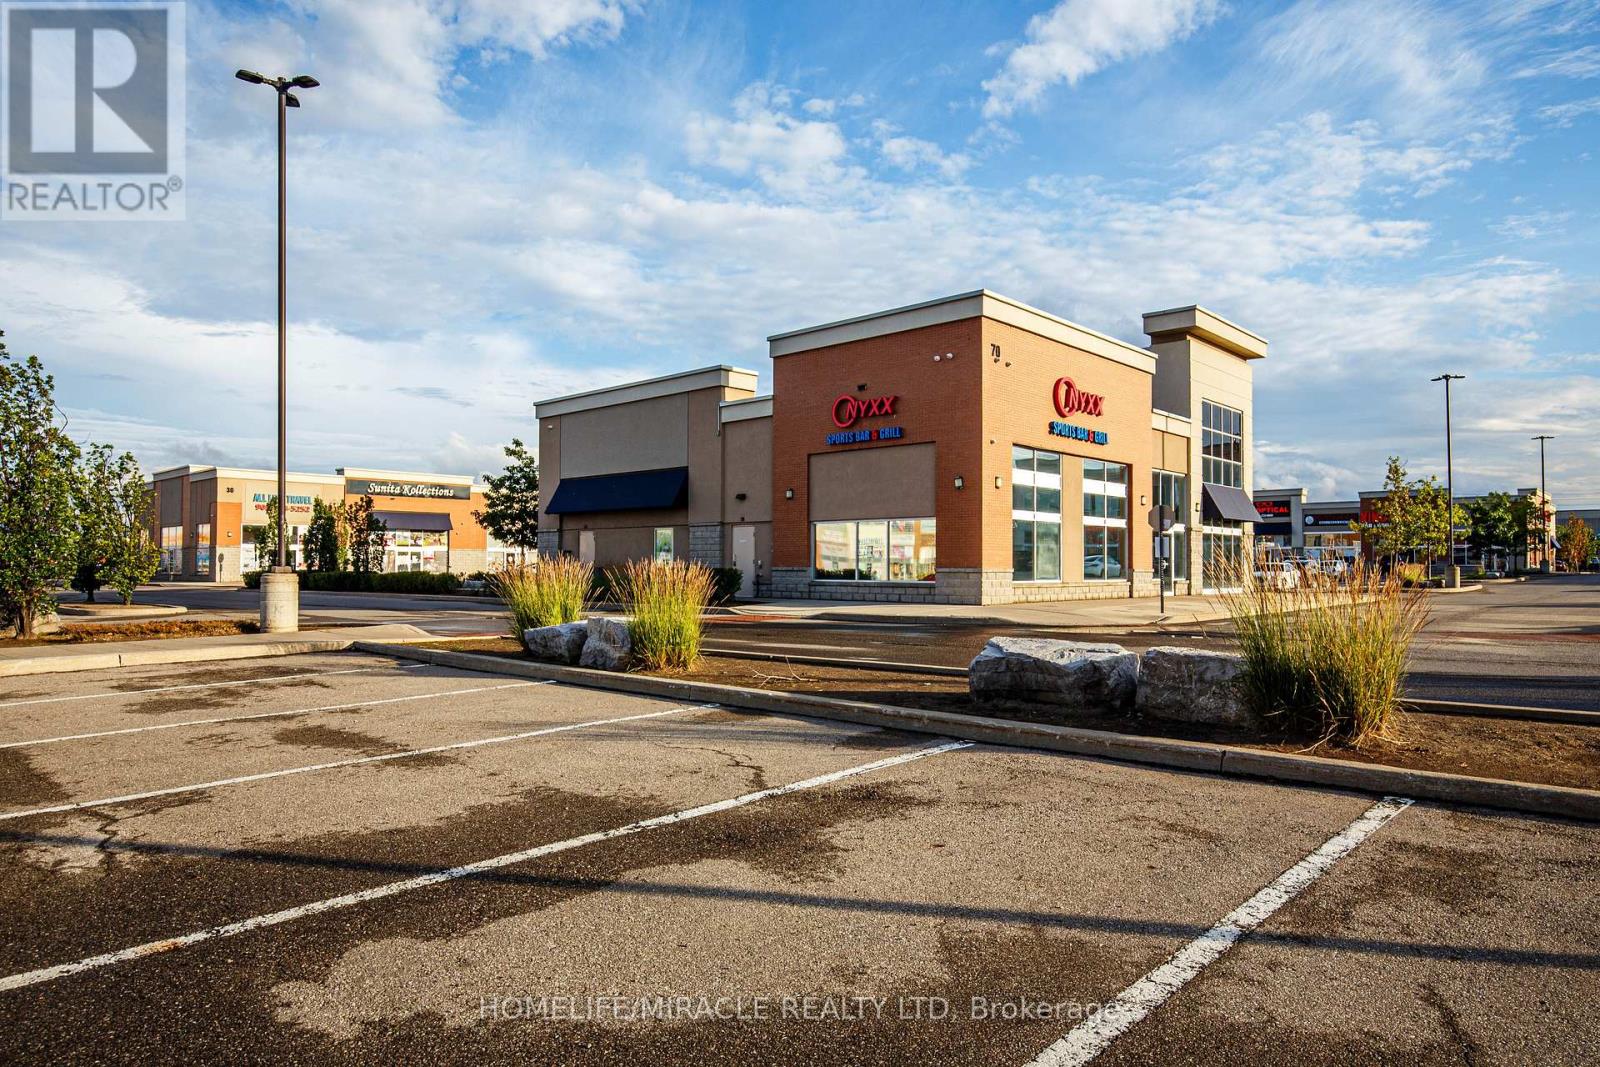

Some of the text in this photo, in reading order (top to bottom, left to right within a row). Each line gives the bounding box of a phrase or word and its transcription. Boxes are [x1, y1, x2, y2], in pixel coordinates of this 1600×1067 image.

[990, 343, 1001, 358] 70
[832, 393, 897, 428] ONYXX
[826, 432, 855, 445] SPORTS
[855, 430, 870, 442] BAR
[879, 427, 902, 439] GRILL
[1049, 421, 1076, 438] SPORTS
[367, 482, 454, 497] Sunita Kollections
[286, 495, 312, 504] TRAVEL
